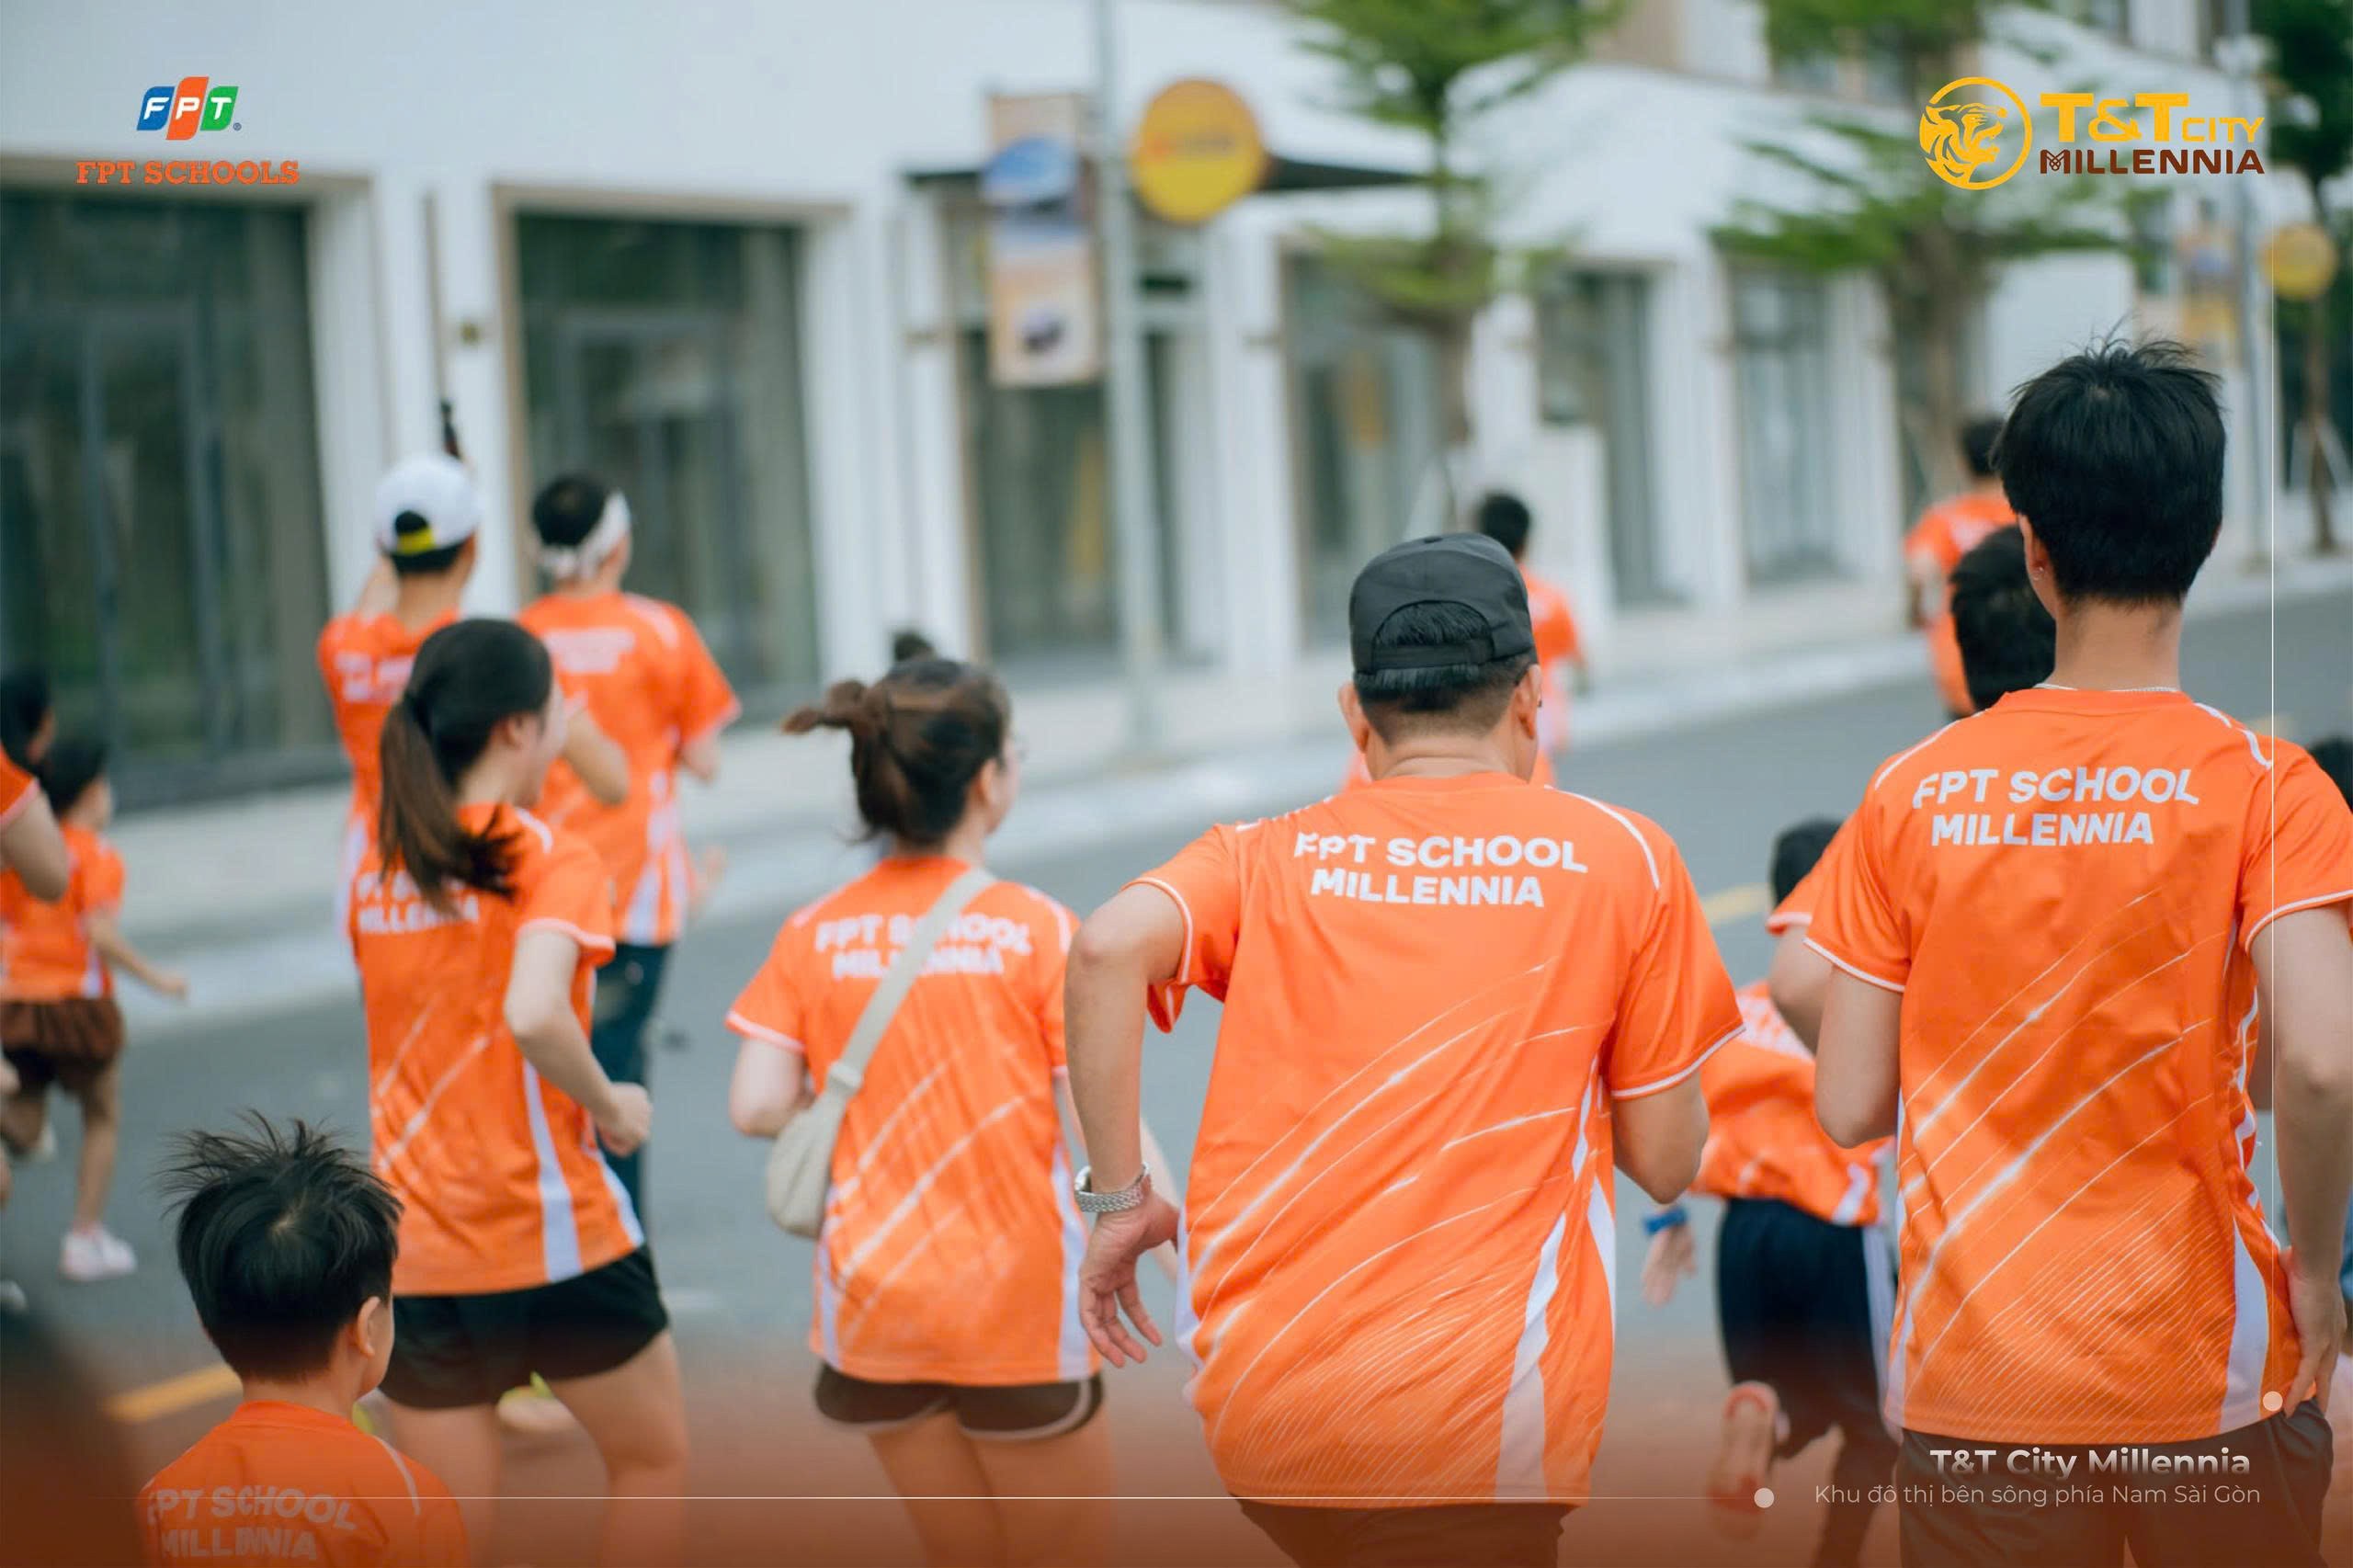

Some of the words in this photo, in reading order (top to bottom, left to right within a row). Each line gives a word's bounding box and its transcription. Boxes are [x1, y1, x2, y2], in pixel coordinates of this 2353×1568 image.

[1912, 768, 1999, 810] FPT
[2007, 766, 2200, 805] SCHOOL
[1931, 812, 2154, 846] MILLENNIA
[1293, 831, 1377, 863] FPT
[1386, 835, 1589, 873] SCHOOL
[1310, 867, 1545, 908] MILLENNIA
[210, 1484, 358, 1530] SCHOOL
